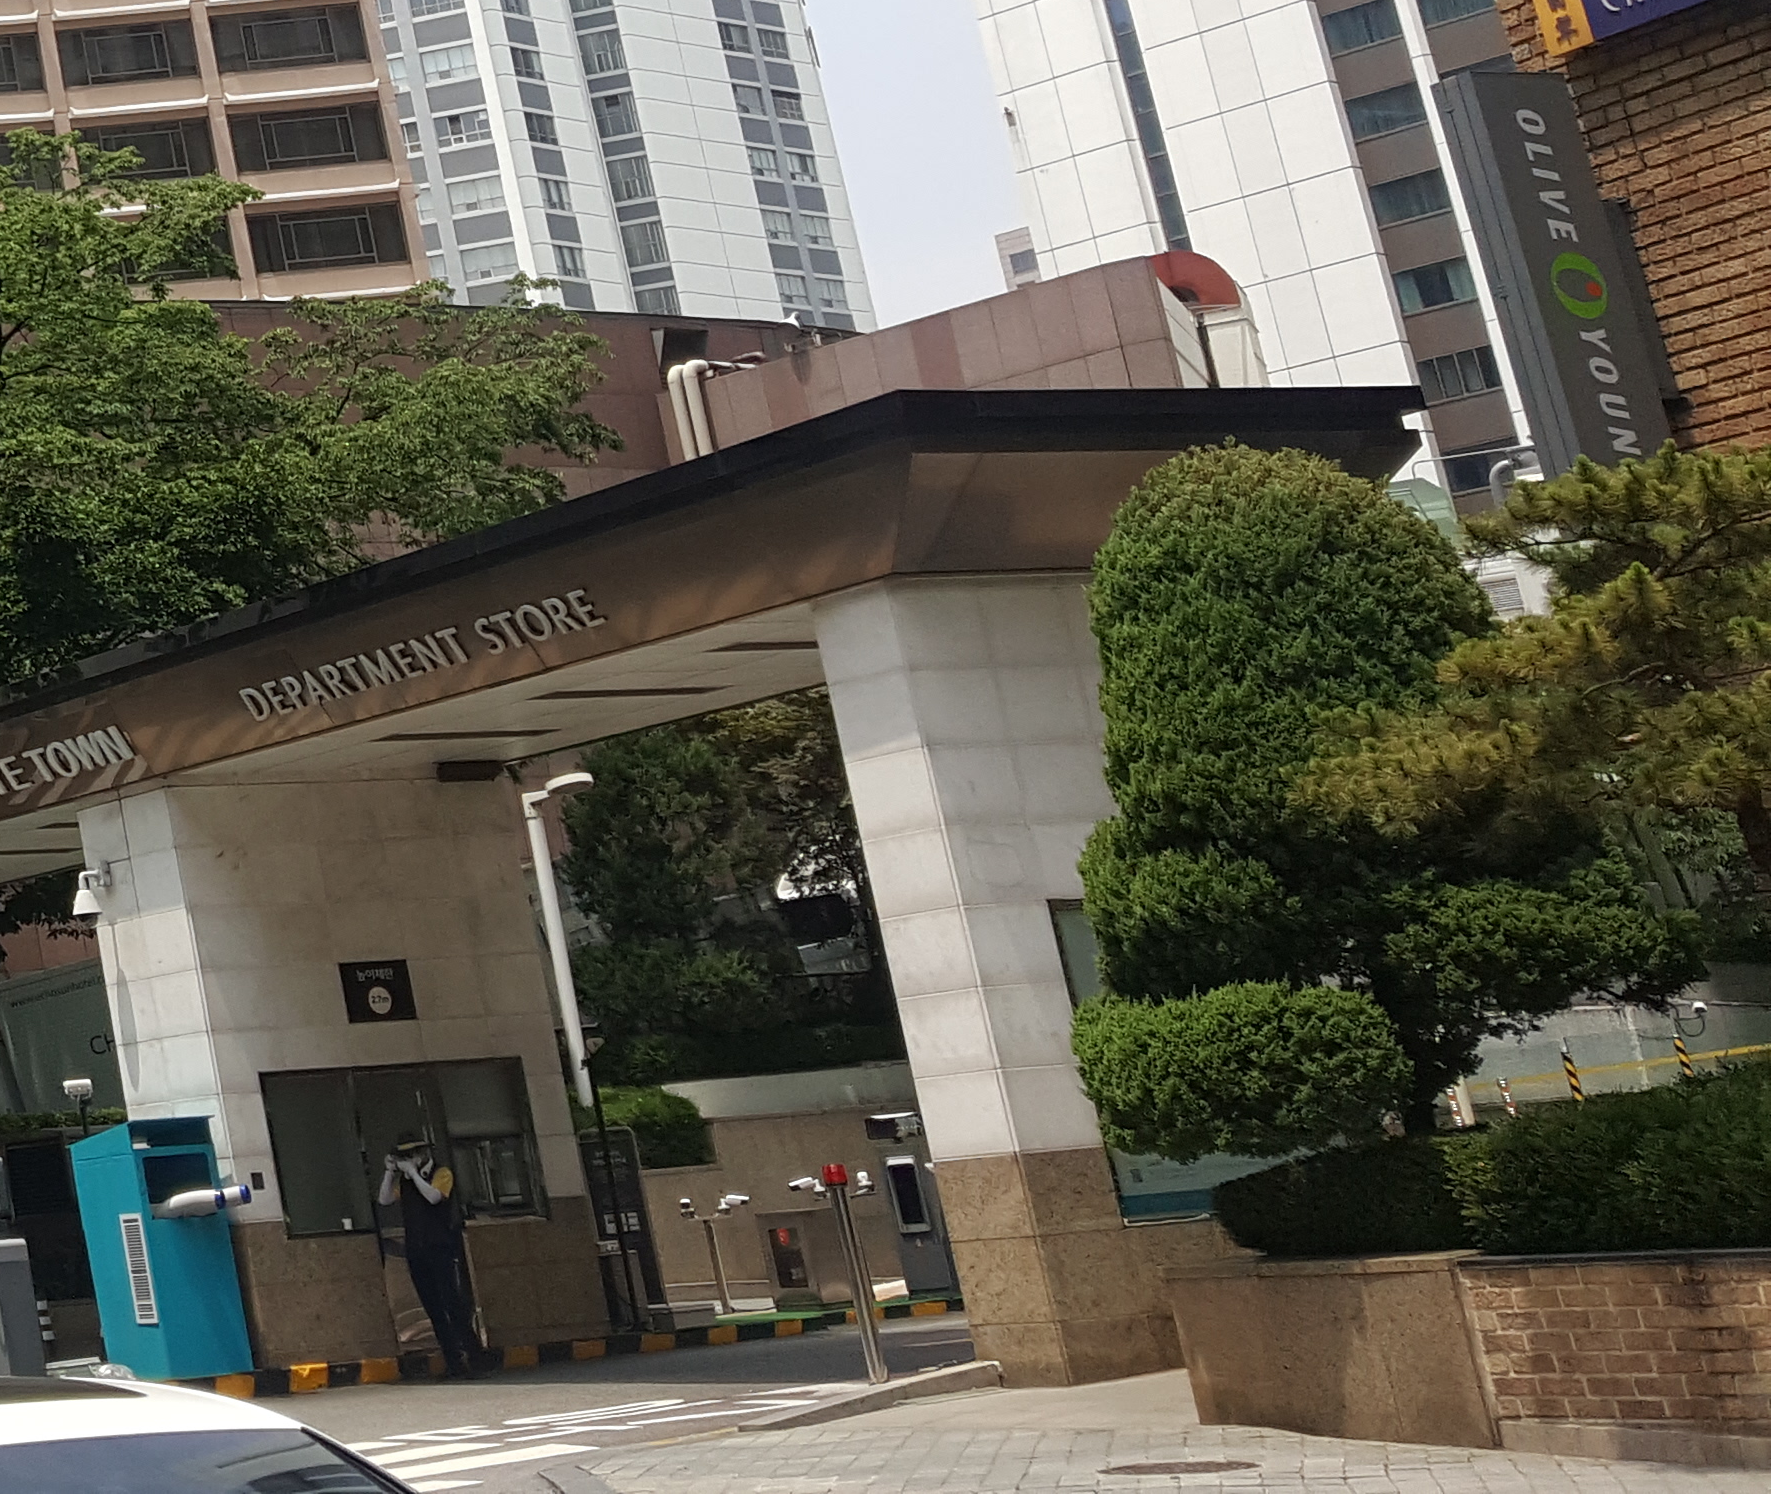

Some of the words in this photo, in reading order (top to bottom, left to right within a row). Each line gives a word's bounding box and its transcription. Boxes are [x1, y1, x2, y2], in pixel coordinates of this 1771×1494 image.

[1514, 107, 1579, 244] OLIVE
[1578, 329, 1643, 457] YOUN
[238, 626, 471, 723] DEPARTMENT
[474, 588, 609, 656] STORE
[22, 725, 136, 783] TOWN
